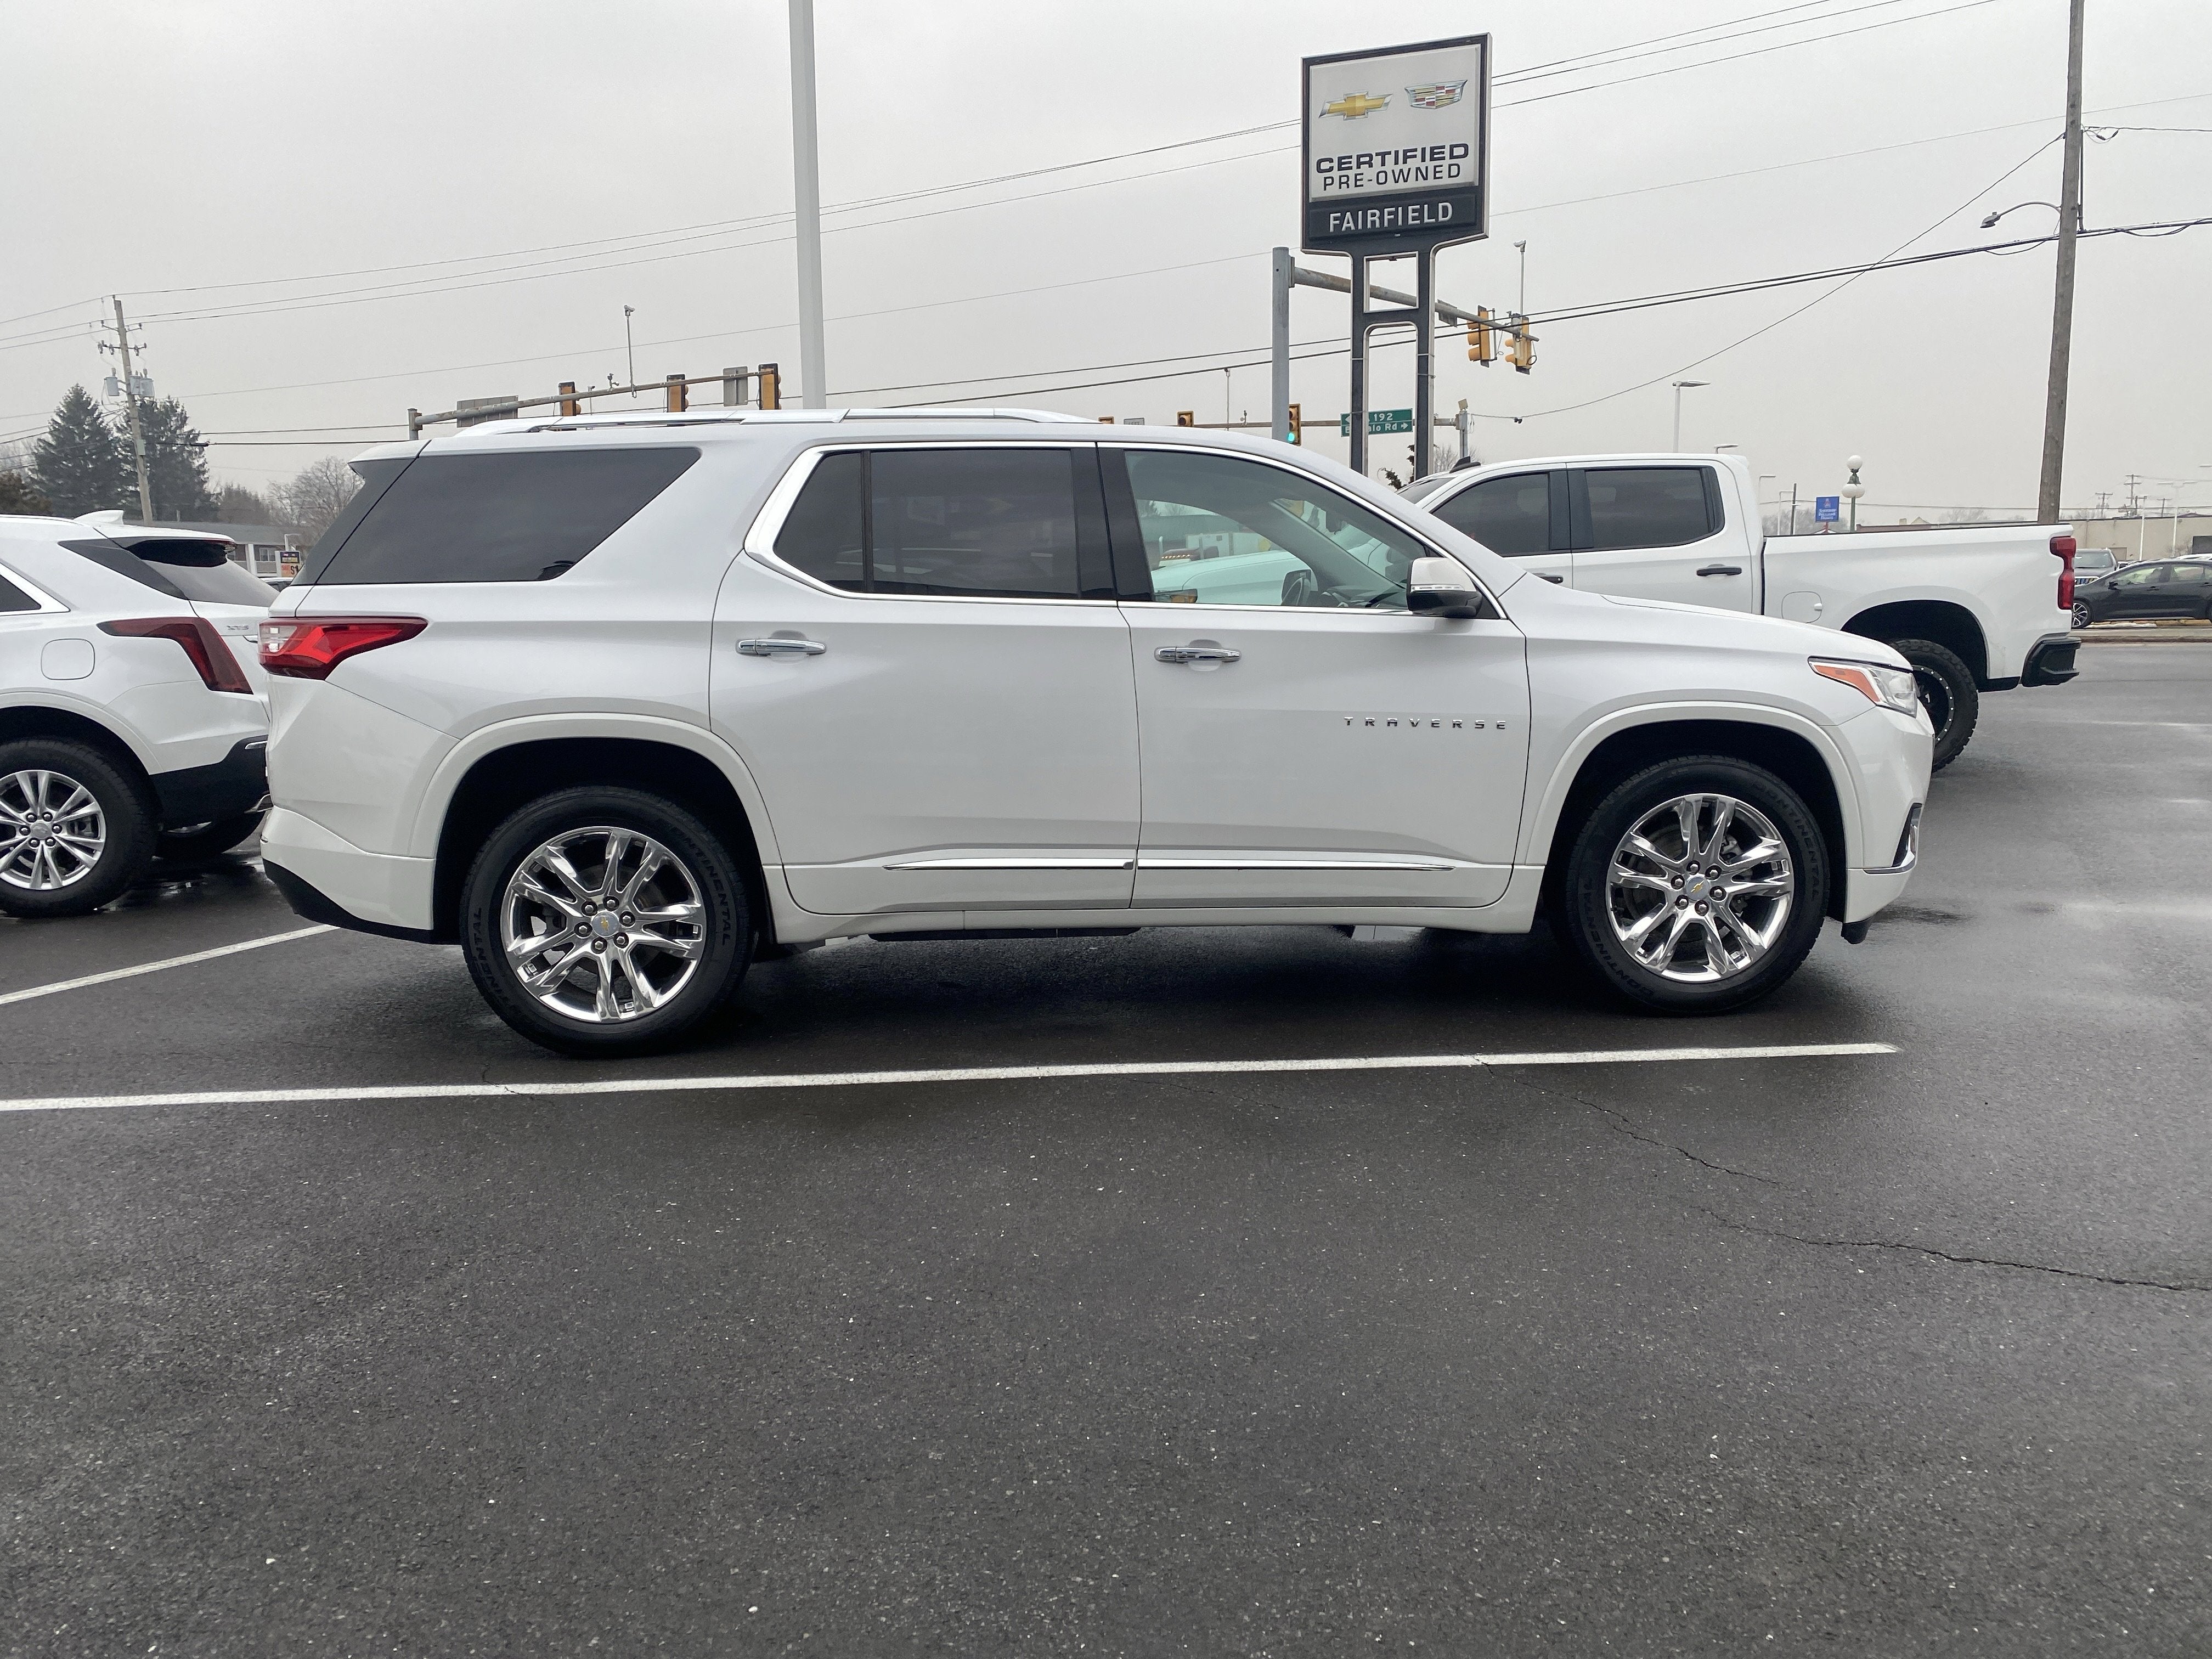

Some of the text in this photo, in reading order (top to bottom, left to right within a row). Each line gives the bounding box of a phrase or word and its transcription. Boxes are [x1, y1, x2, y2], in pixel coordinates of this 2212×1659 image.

[1316, 143, 1469, 173] CERTIFIED
[1323, 162, 1460, 191] PRE-OWNED
[1329, 201, 1453, 233] FAIRFIELD
[1374, 413, 1393, 421] 192
[1385, 422, 1397, 431] Rd
[1344, 716, 1506, 729] TRAVERSE
